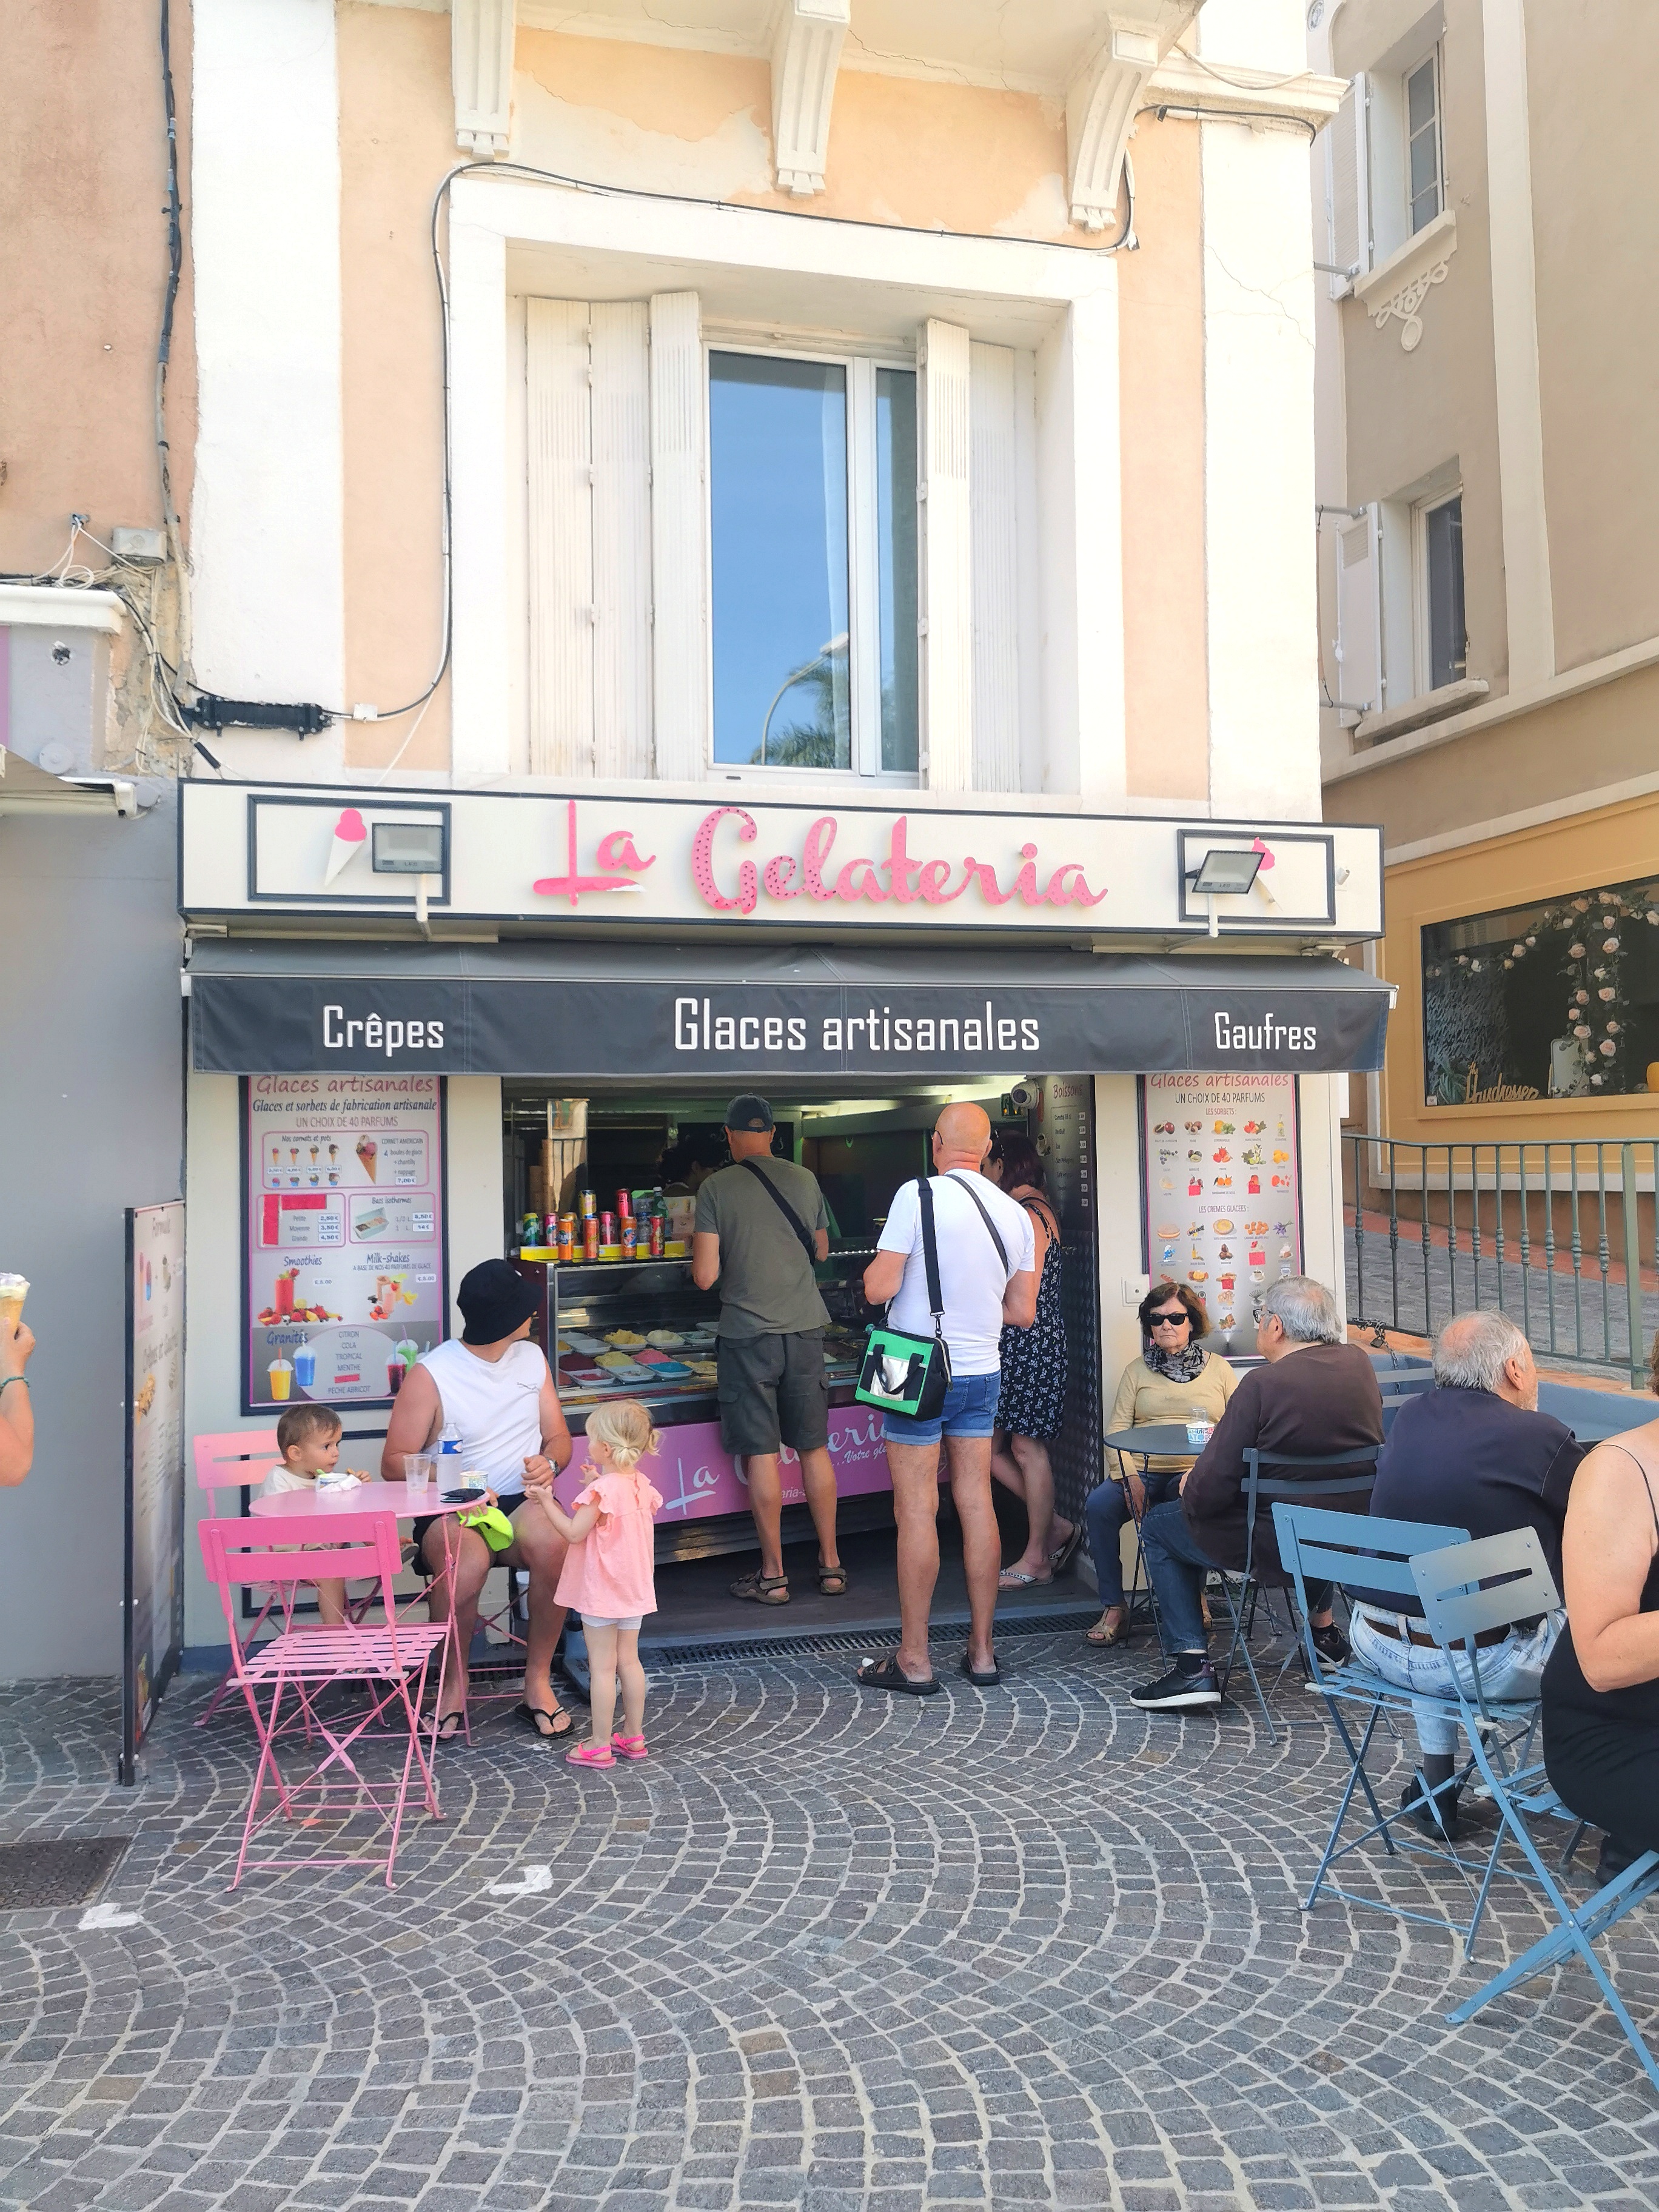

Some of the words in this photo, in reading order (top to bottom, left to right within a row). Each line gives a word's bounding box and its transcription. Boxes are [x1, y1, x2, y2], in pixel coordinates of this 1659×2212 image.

[532, 800, 657, 907] La
[692, 806, 1108, 915] Gelateria
[323, 1005, 444, 1057] Crêpes
[674, 997, 806, 1051] Glaces
[822, 1000, 1040, 1051] artisanales
[1215, 1012, 1316, 1050] Gaufres
[256, 1076, 319, 1094] Glaces
[327, 1075, 434, 1093] artisanales
[1150, 1074, 1199, 1088] Glaces
[1205, 1074, 1289, 1087] artisanales
[252, 1099, 283, 1112] Glaces
[285, 1101, 293, 1111] et
[295, 1099, 327, 1111] sorbets
[329, 1099, 341, 1111] de
[341, 1098, 391, 1114] fabrication
[394, 1098, 437, 1111] artisanale
[1175, 1093, 1185, 1104] UN
[1187, 1093, 1210, 1103] CHOIX
[1211, 1093, 1221, 1103] DE
[1222, 1093, 1230, 1103] 40
[1232, 1093, 1265, 1103] PARFUMS
[296, 1117, 308, 1128] UN
[310, 1116, 335, 1128] CHOIX
[337, 1116, 347, 1127] DE
[349, 1116, 359, 1127] 40
[361, 1116, 398, 1127] PARFUMS
[284, 1255, 322, 1267] Smoothies
[367, 1252, 411, 1264] Milk-shakes
[665, 1457, 720, 1515] La
